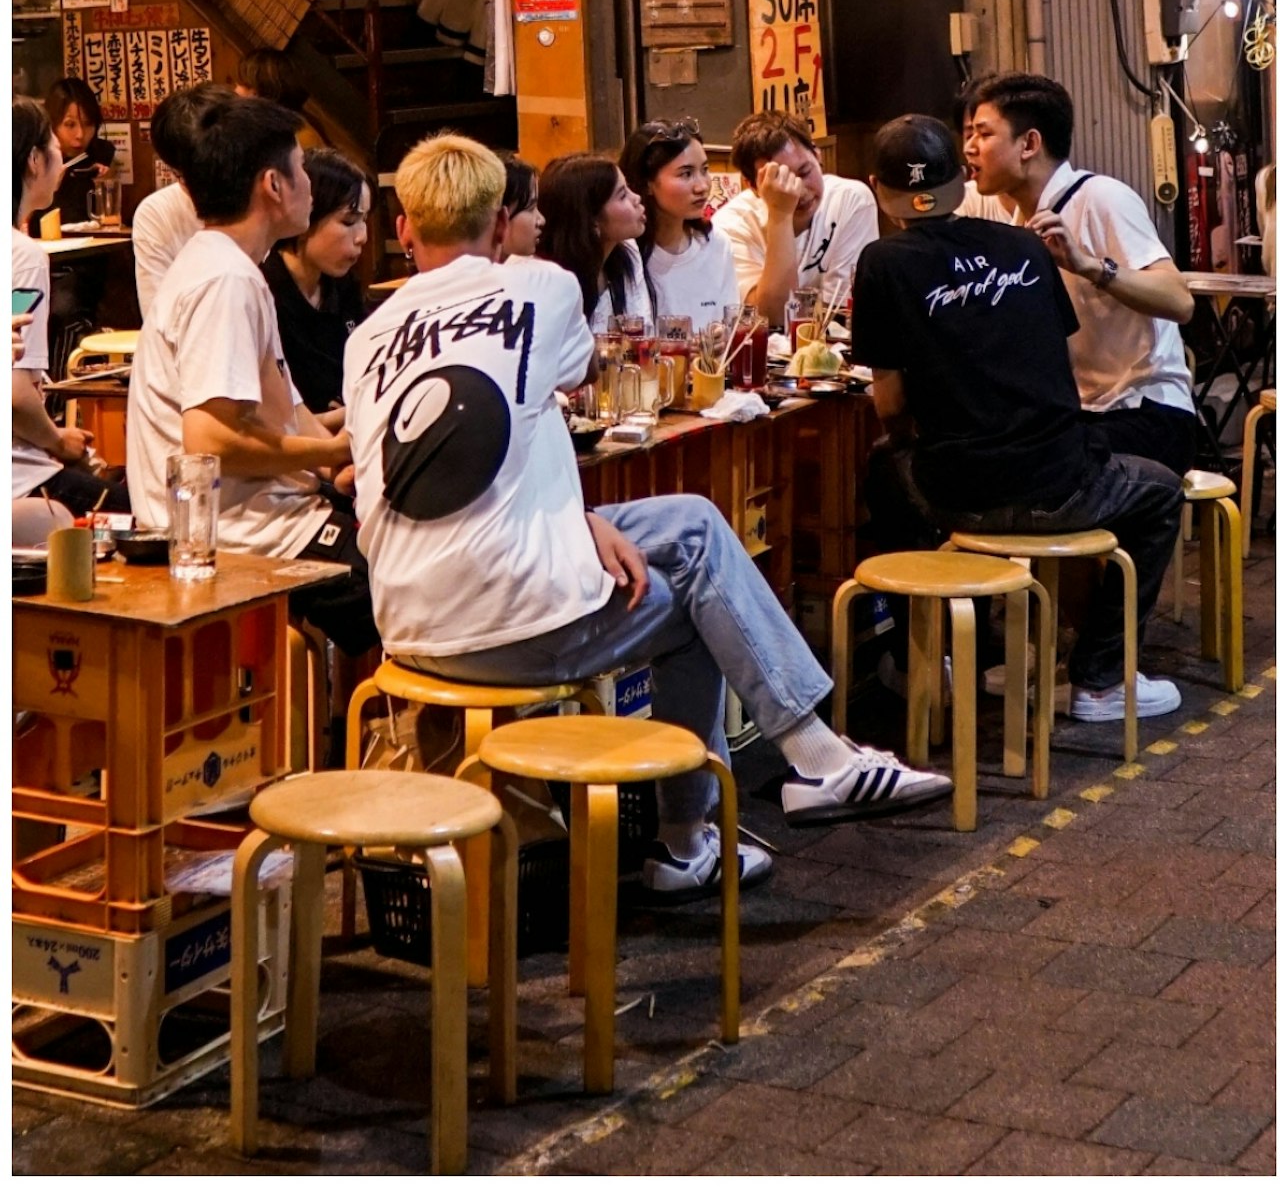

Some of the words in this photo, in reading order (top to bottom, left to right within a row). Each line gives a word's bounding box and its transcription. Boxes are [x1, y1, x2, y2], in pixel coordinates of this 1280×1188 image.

[954, 255, 989, 273] AIR
[926, 283, 975, 317] Fear
[974, 268, 998, 295] of
[991, 259, 1040, 306] god
